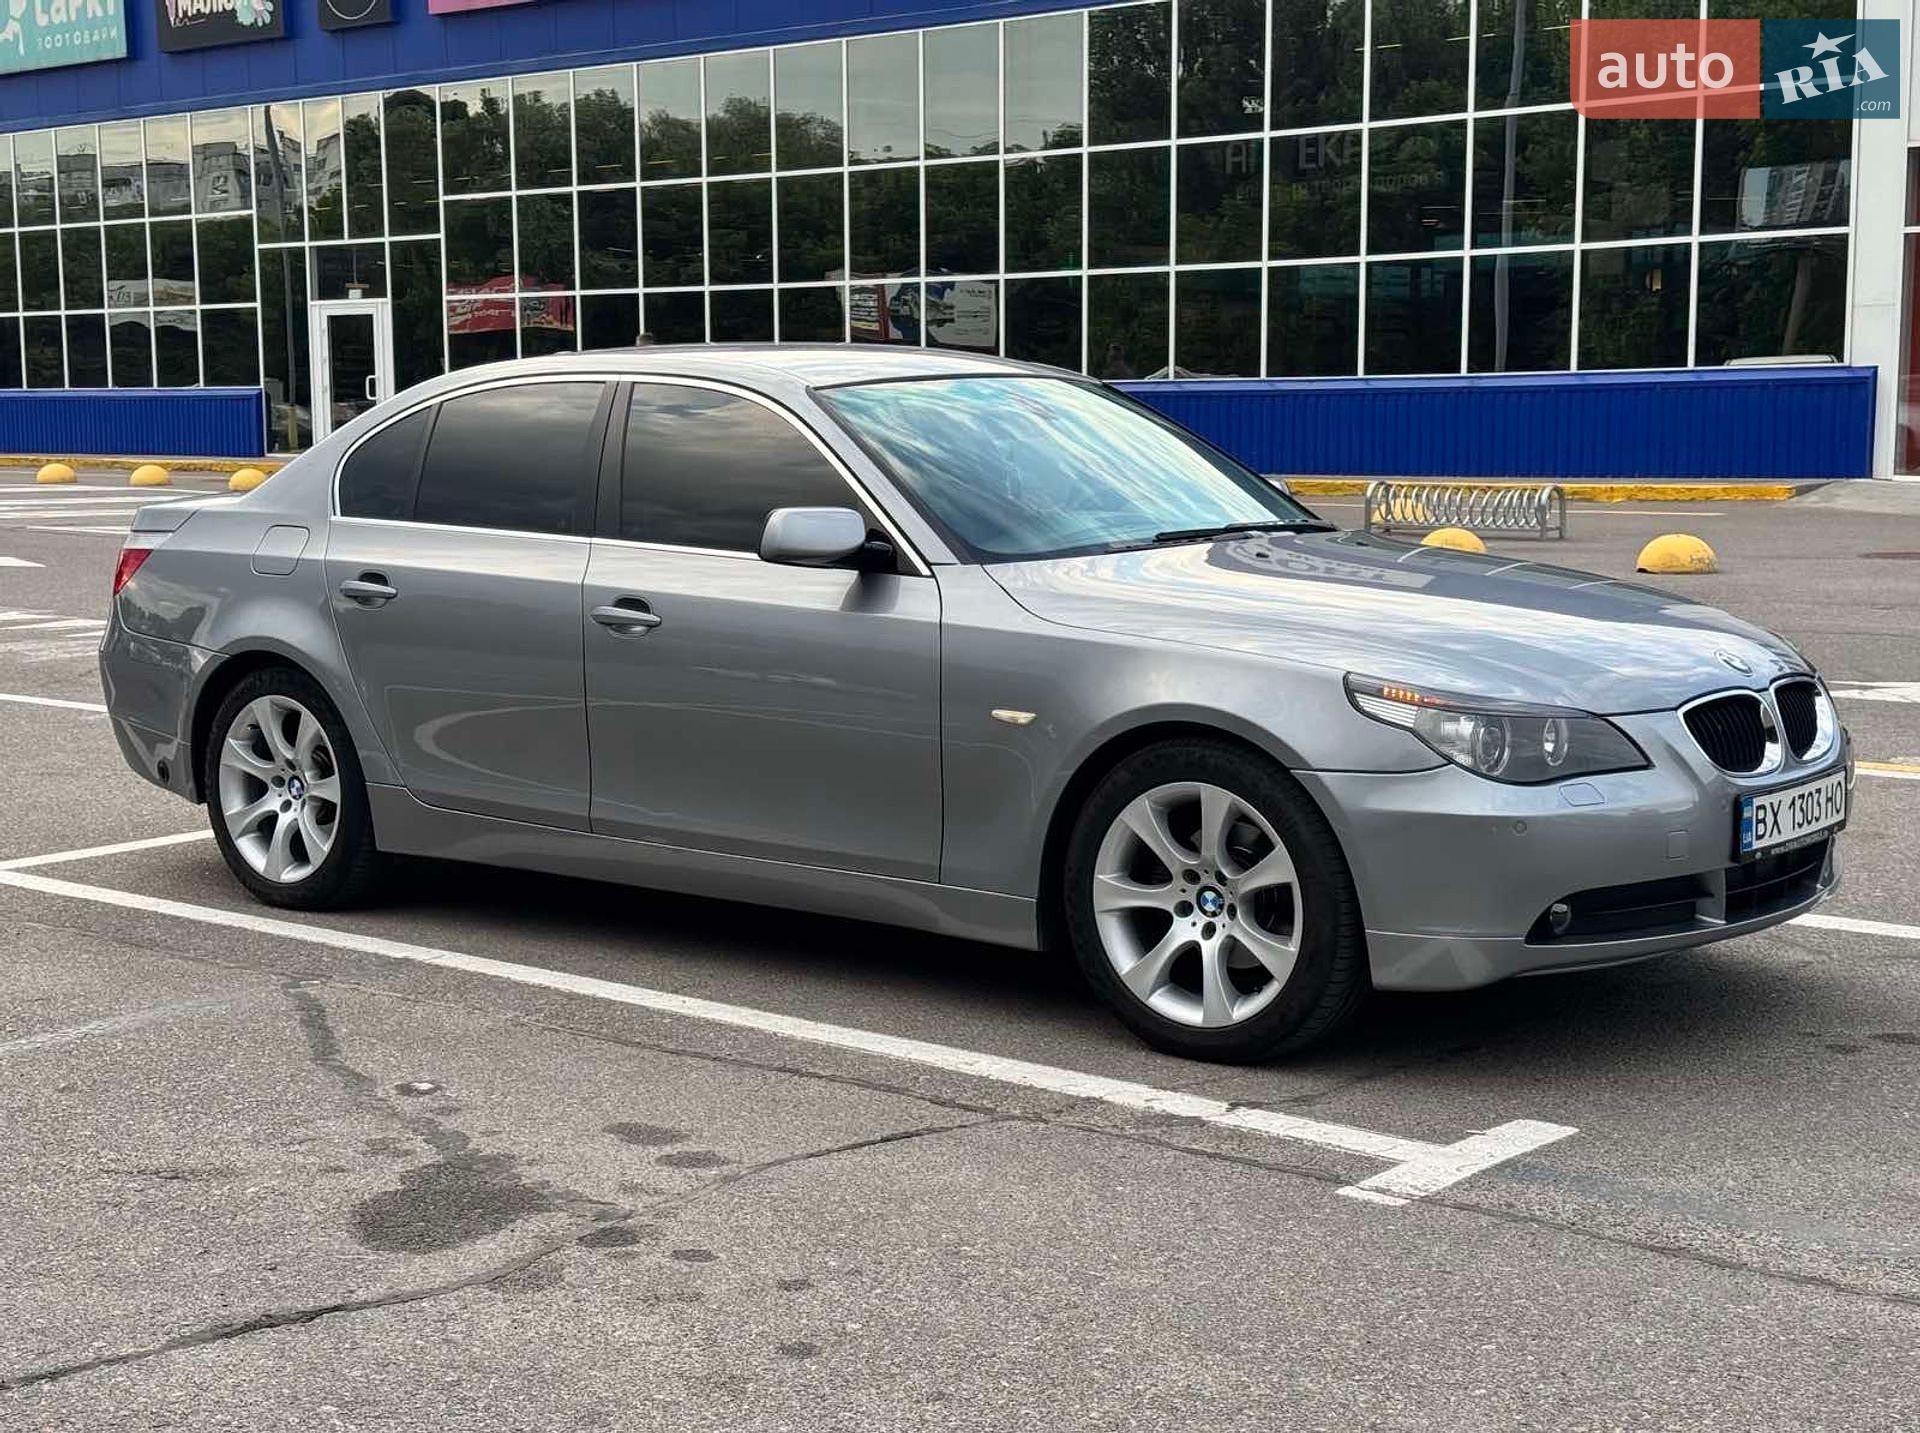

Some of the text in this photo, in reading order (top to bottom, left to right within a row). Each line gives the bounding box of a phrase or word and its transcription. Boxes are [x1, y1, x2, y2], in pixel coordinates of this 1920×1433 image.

[1755, 781, 1843, 840] BX 1303 HO
